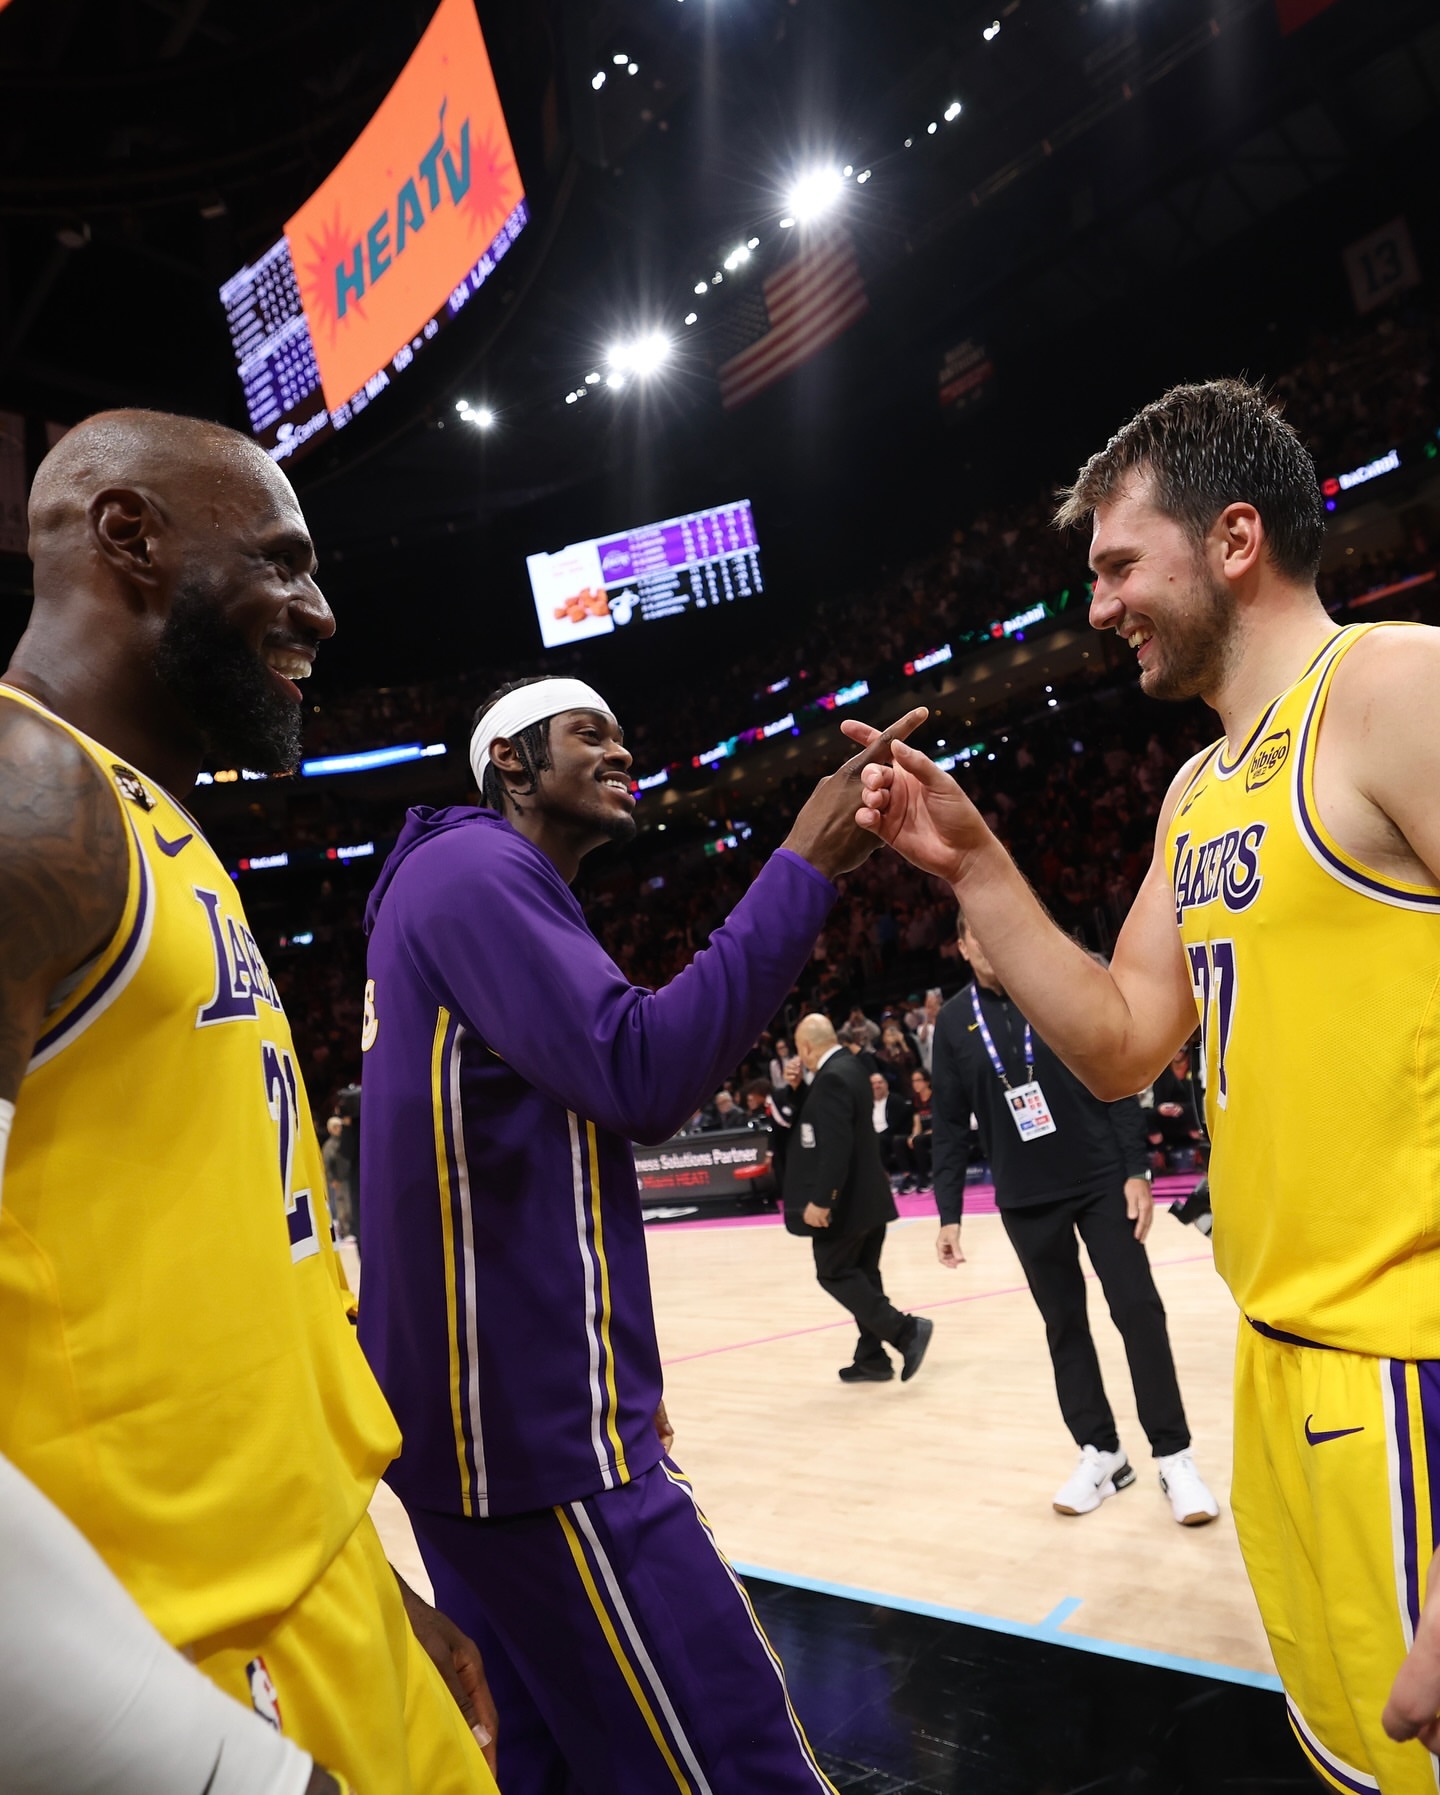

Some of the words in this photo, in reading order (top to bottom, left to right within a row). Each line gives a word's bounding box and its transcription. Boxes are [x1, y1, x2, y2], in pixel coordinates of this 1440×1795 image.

[1251, 746, 1287, 773] bibigo
[1174, 820, 1269, 927] LAKERS
[1185, 937, 1238, 1112] 77
[660, 1151, 713, 1170] Solutions
[712, 1148, 758, 1165] Partner
